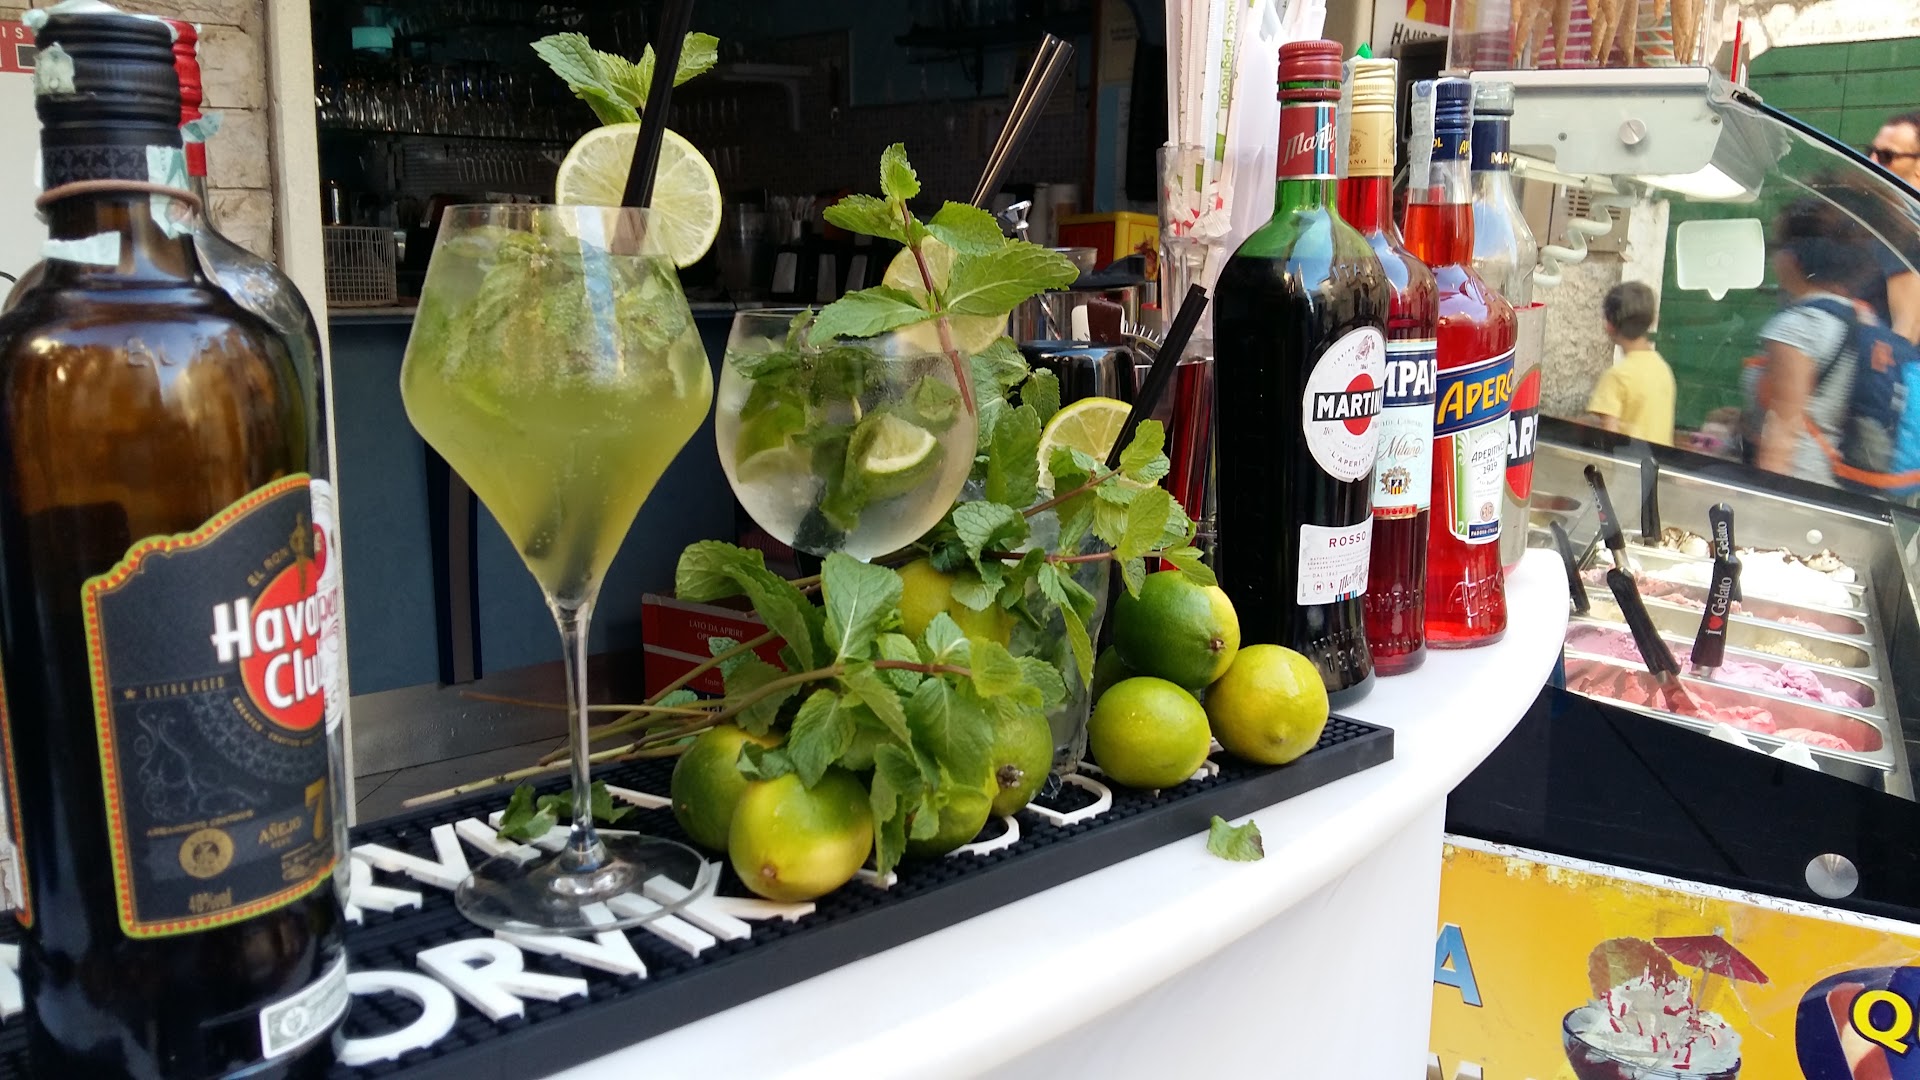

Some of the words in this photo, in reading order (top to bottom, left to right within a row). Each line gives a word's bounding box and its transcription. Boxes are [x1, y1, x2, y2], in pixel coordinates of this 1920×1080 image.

[1328, 530, 1367, 548] ROSSO
[1717, 520, 1730, 558] Gelato
[1711, 577, 1733, 617] Gelato
[145, 681, 187, 698] EXTRA
[192, 676, 226, 693] AGED
[304, 777, 326, 840] 7
